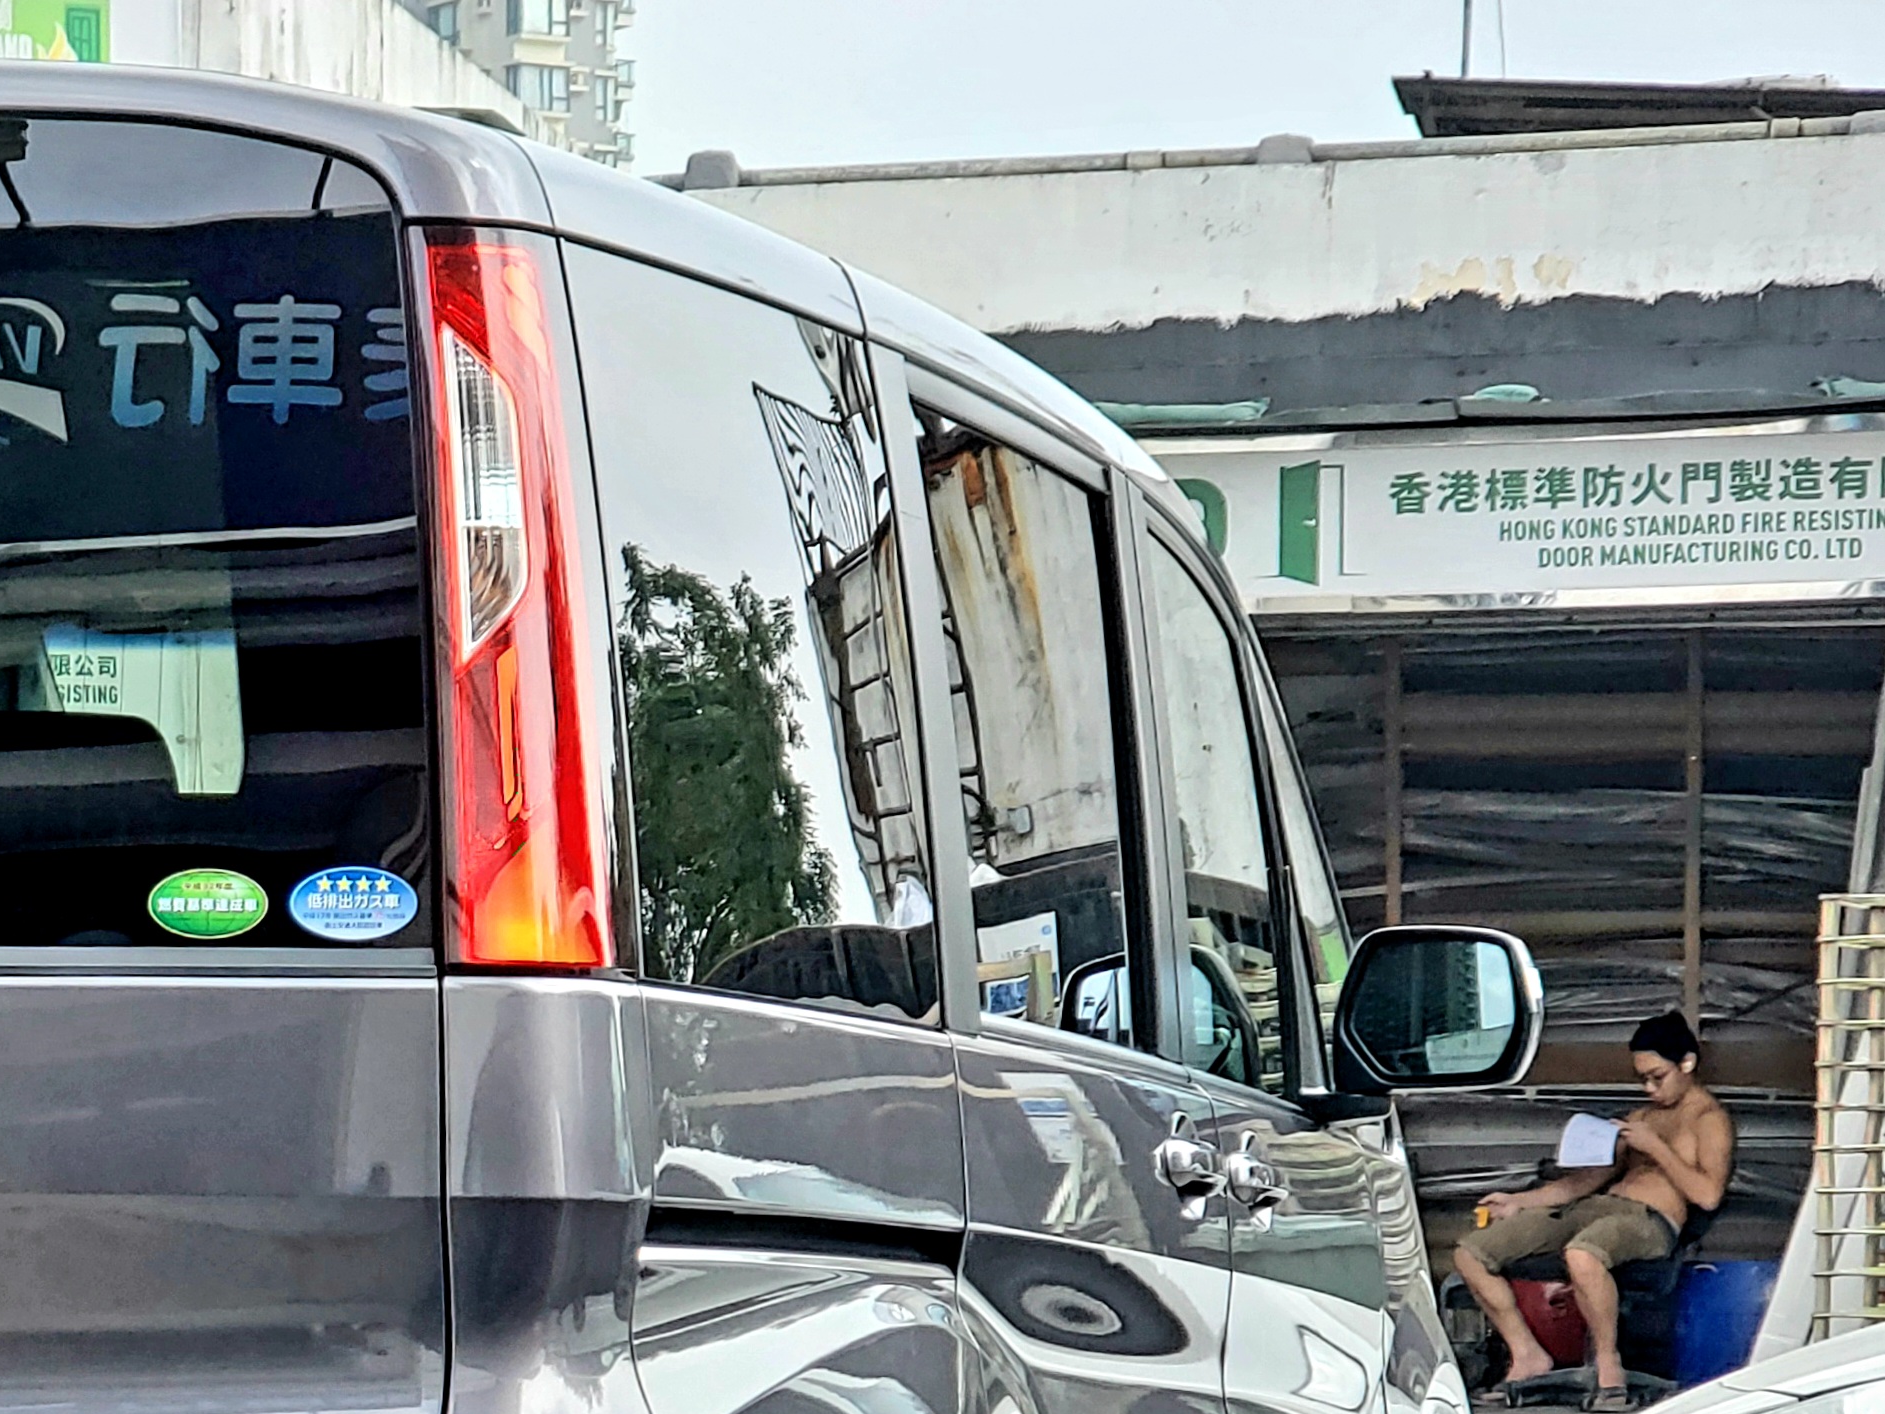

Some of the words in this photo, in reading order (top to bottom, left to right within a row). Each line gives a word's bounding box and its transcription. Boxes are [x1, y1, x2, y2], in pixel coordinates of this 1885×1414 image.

[1389, 456, 1885, 515] 香港標準防火門製造有
[1499, 519, 1556, 542] HONG
[1562, 517, 1618, 539] KONG
[1623, 513, 1736, 537] STANDARD
[1741, 511, 1787, 533] FIRE
[1538, 546, 1594, 568] DOOR
[1599, 540, 1779, 566] MANUFACTURING
[1784, 538, 1820, 560] CO.
[1826, 537, 1863, 559] LTD
[307, 892, 400, 909] 低排出ガス車
